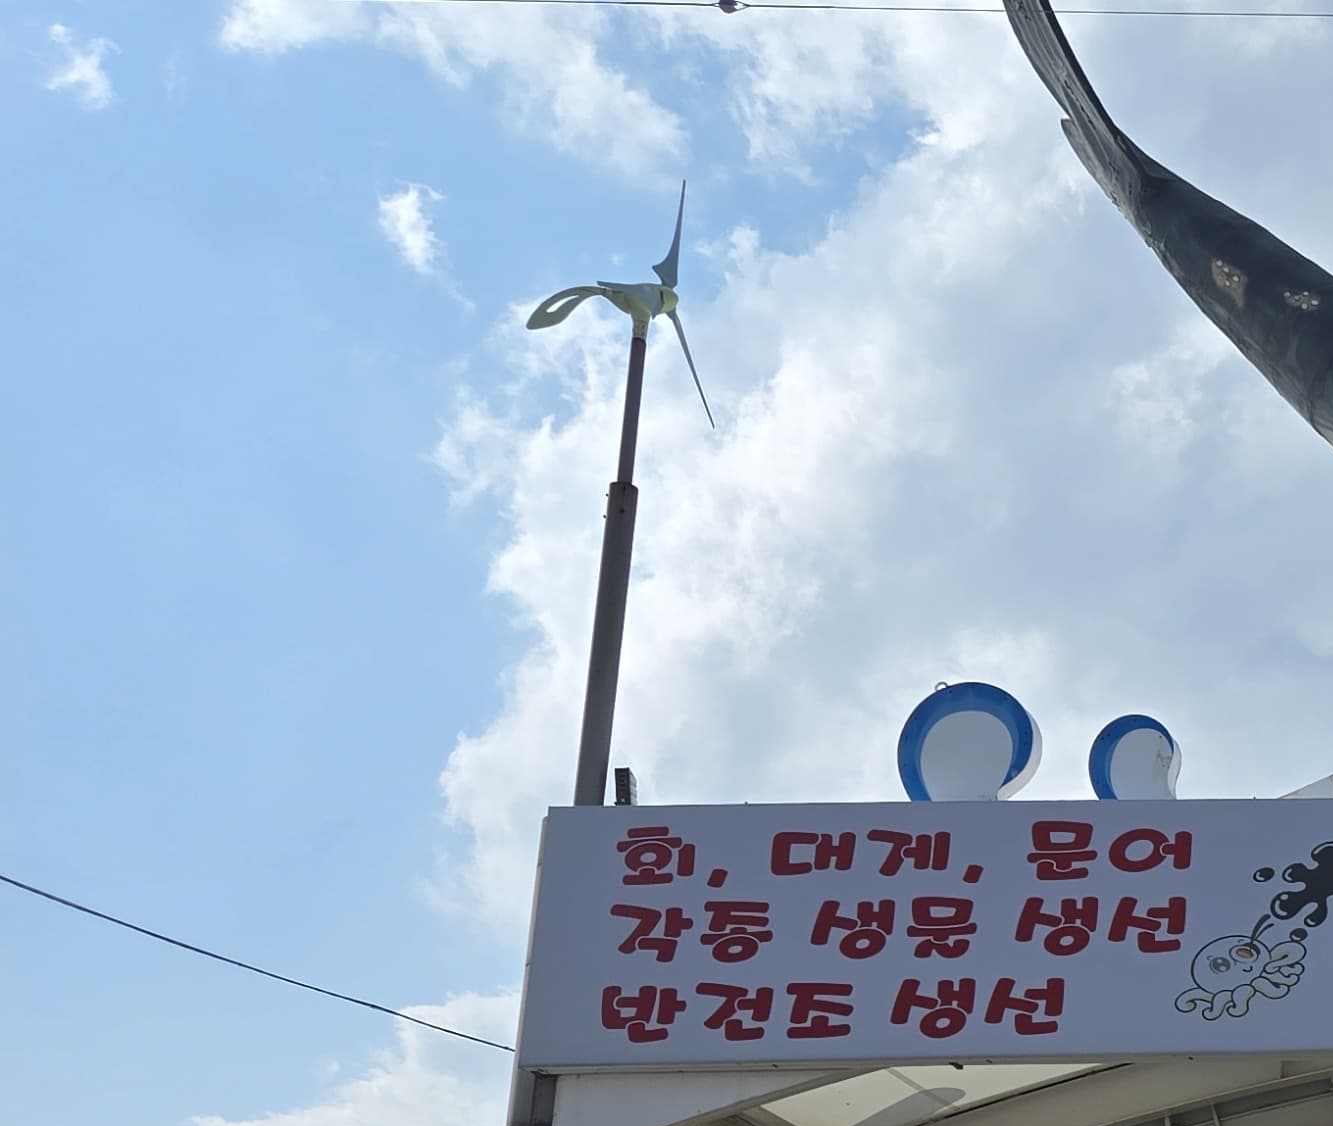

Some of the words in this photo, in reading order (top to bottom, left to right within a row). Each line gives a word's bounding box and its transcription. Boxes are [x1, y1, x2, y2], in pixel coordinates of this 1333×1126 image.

[616, 826, 729, 889] 회,
[771, 828, 985, 885] 대게,
[1026, 820, 1193, 881] 문어
[610, 901, 774, 963] 각종
[810, 896, 978, 960] 생물
[1014, 895, 1188, 956] 생선
[601, 981, 854, 1044] 반건조
[890, 977, 1067, 1040] 생선
